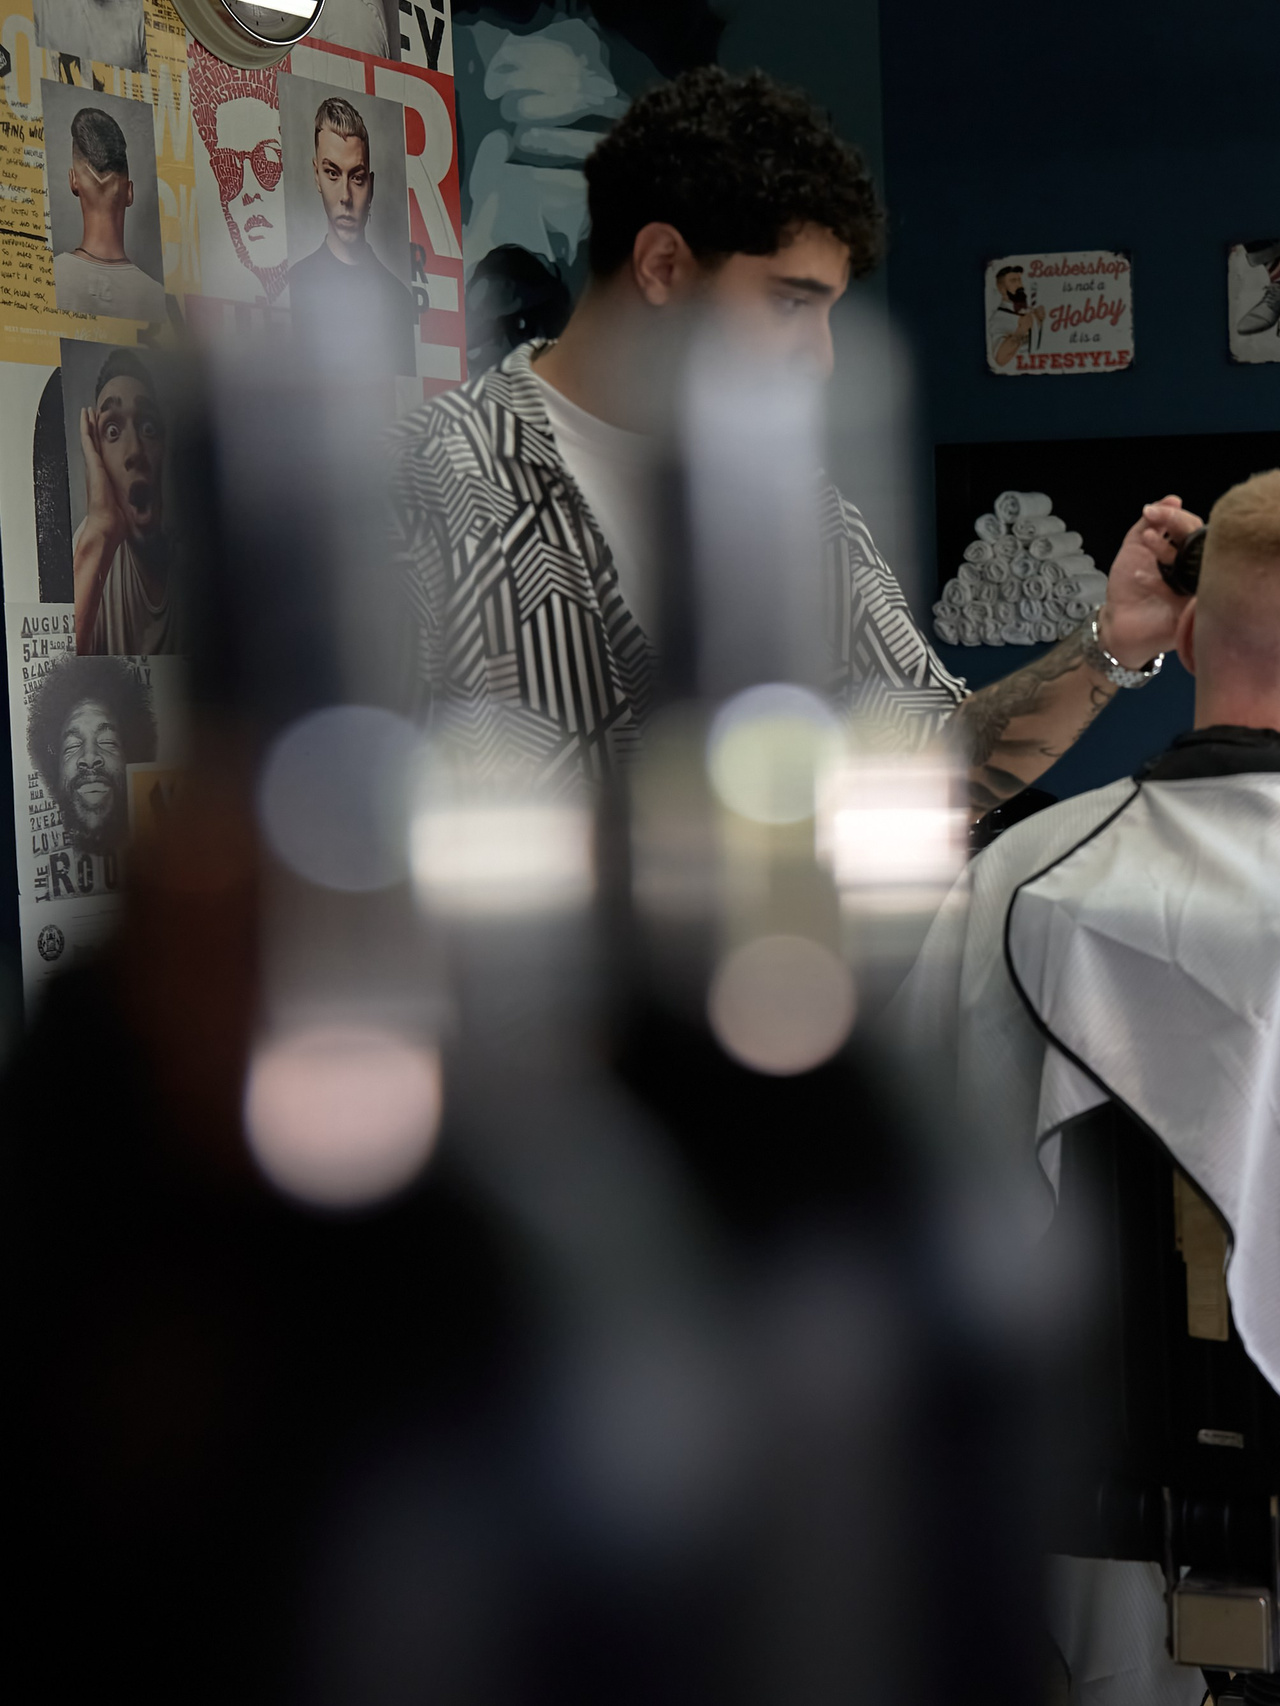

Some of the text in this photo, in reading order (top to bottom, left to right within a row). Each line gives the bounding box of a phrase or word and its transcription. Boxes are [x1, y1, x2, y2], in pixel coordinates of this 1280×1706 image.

[1028, 256, 1130, 281] Barbershop
[1062, 279, 1105, 292] is not a
[1049, 294, 1126, 333] Hobby
[1069, 331, 1101, 343] it is a
[1016, 350, 1131, 370] LIFESTYLE
